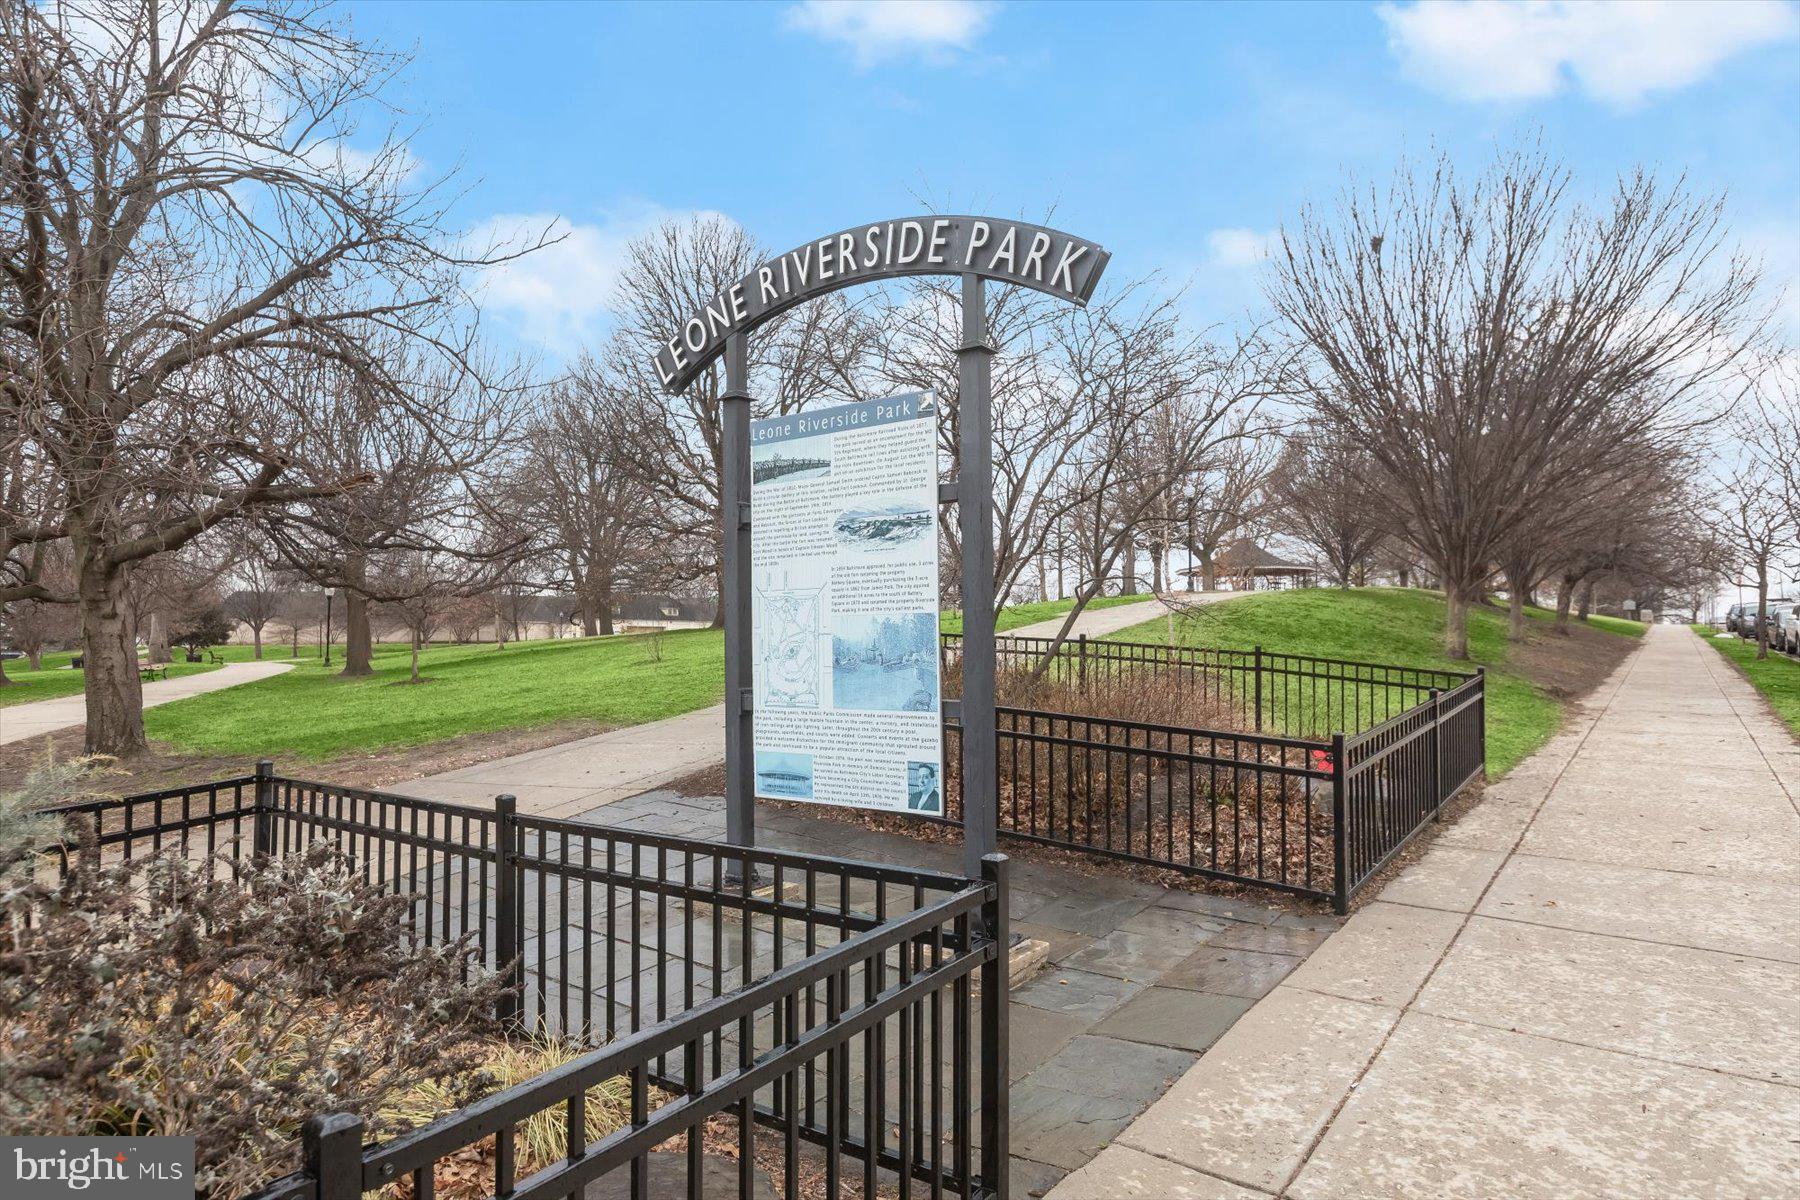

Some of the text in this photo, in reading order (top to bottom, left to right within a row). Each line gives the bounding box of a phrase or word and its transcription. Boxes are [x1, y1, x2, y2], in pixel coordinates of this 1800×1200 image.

[653, 219, 1088, 384] LEONE RIVERSIDE PARK
[752, 401, 911, 441] Leone Riverside Park
